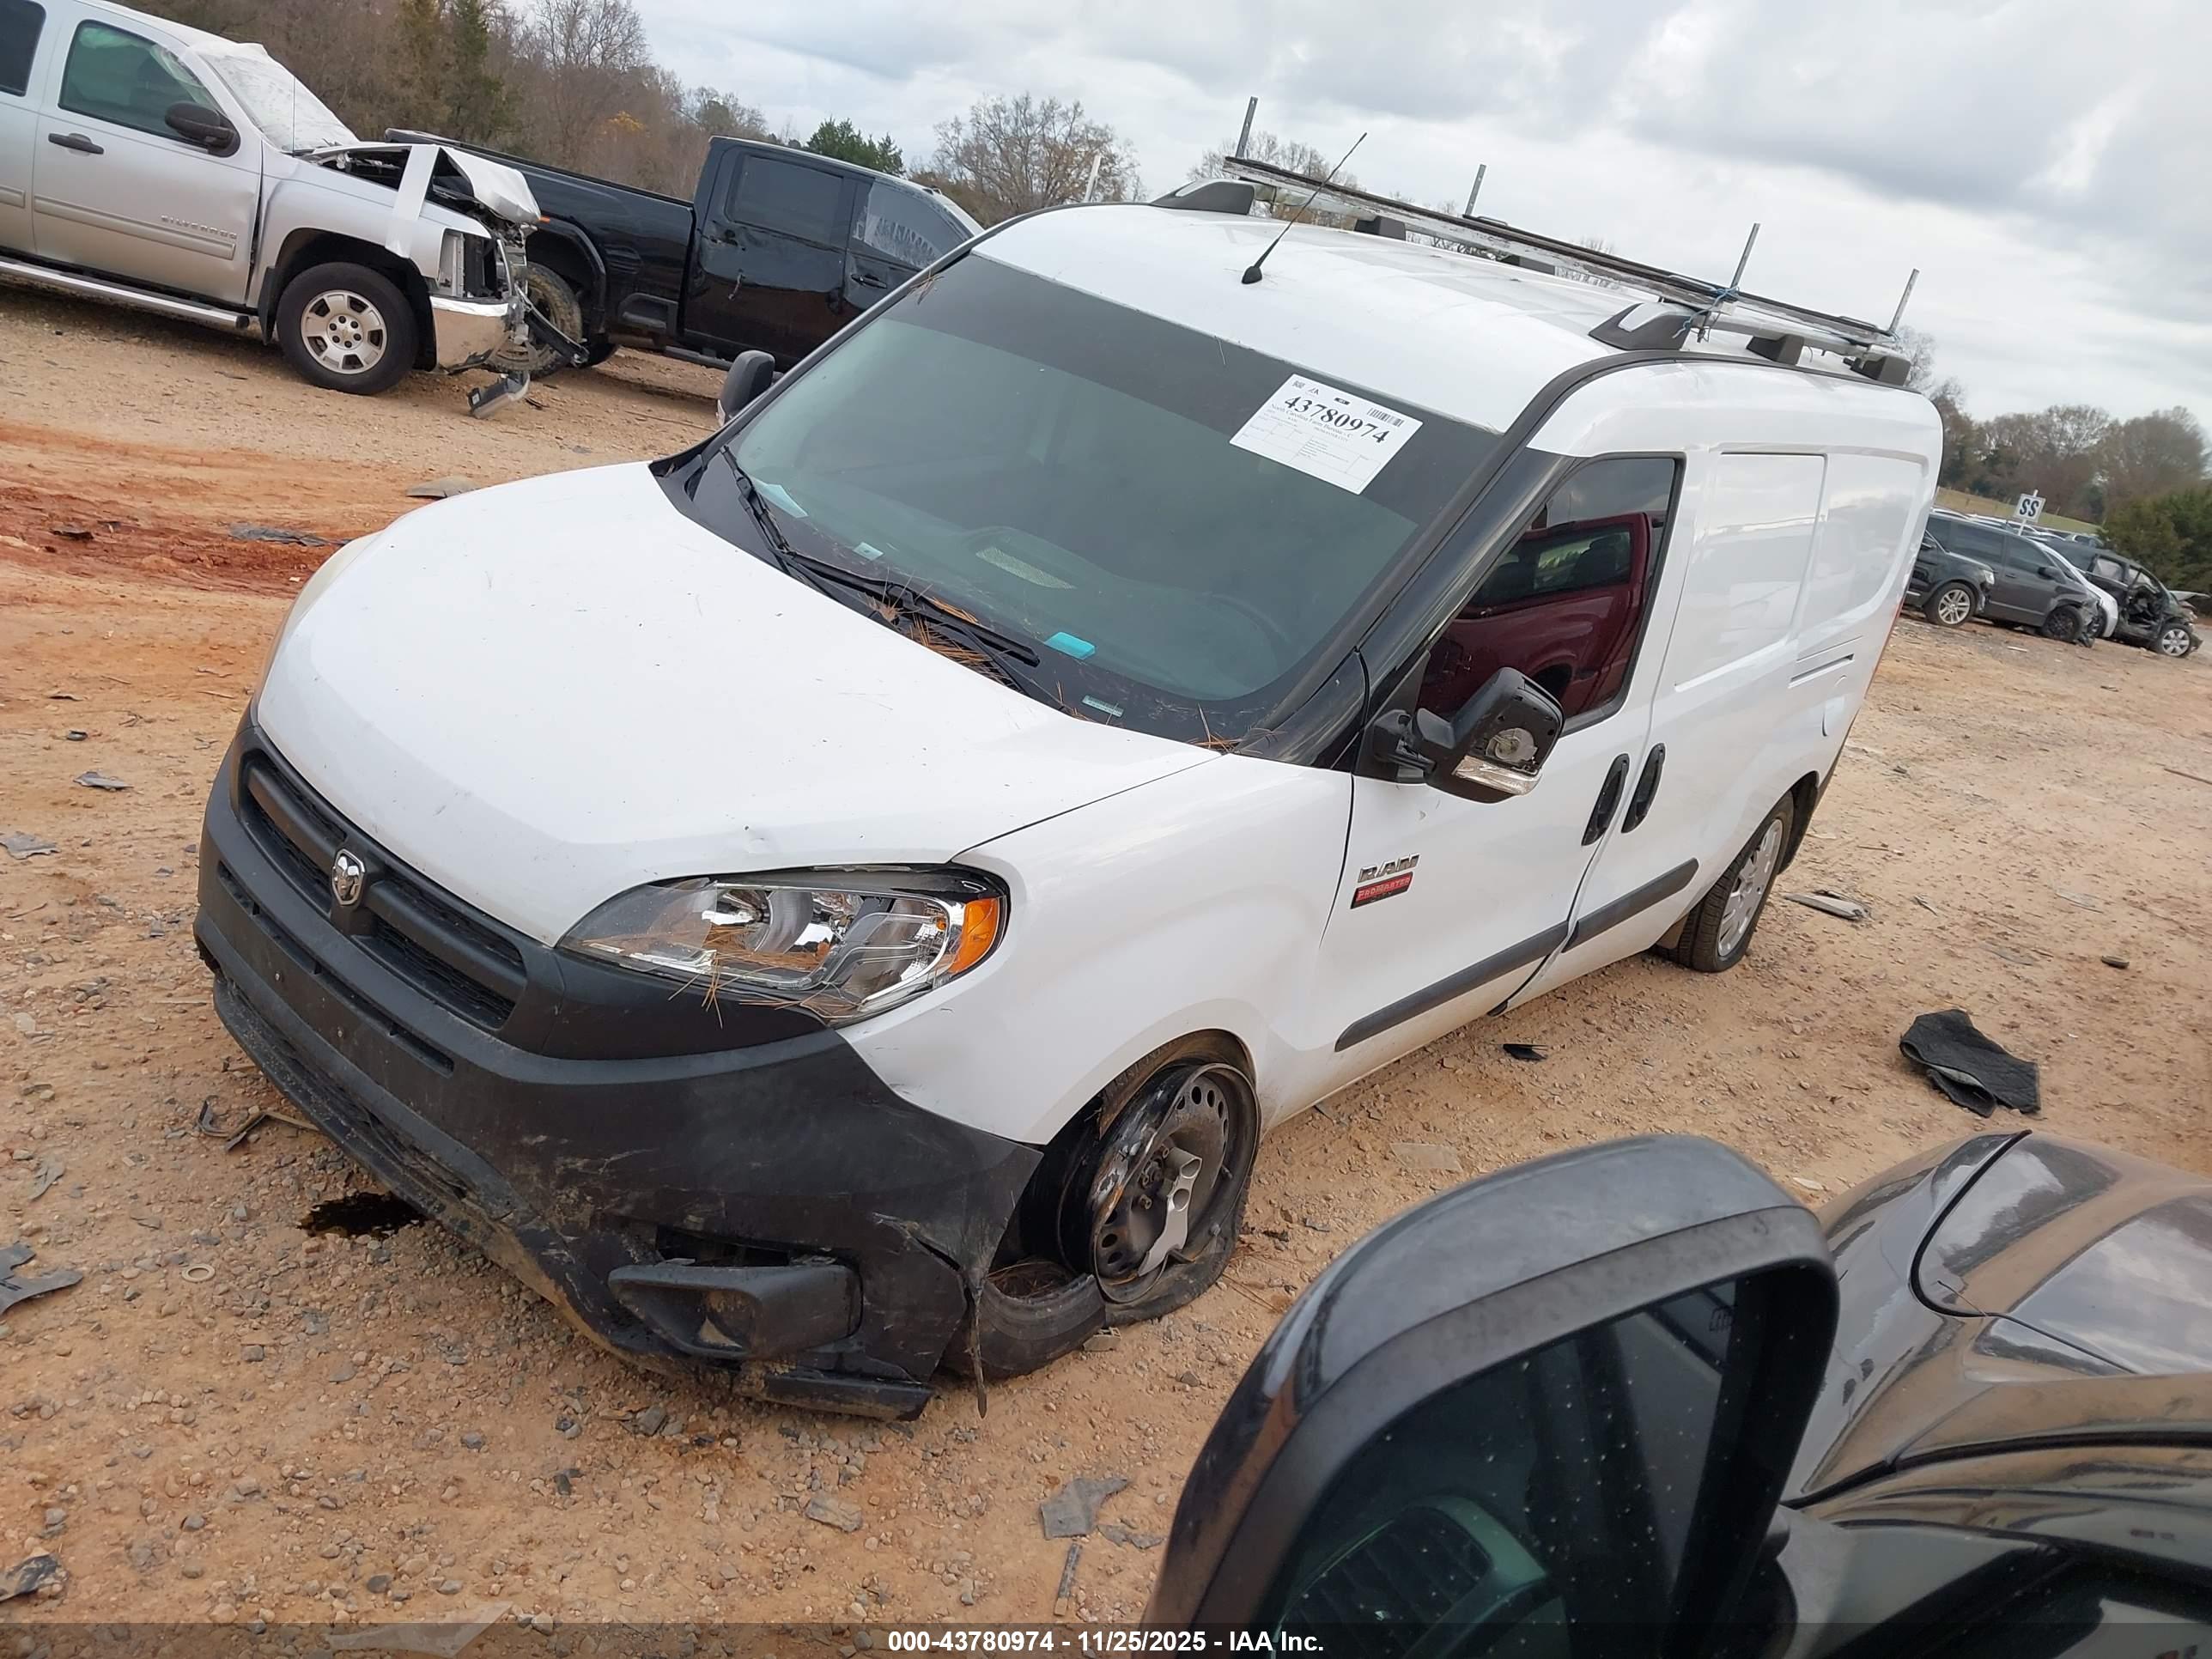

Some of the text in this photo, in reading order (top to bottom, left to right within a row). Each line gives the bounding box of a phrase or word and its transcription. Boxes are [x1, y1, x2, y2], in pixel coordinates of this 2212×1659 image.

[1285, 396, 1389, 443] 43780974
[2020, 498, 2039, 517] SS
[1358, 854, 1419, 883] RAM
